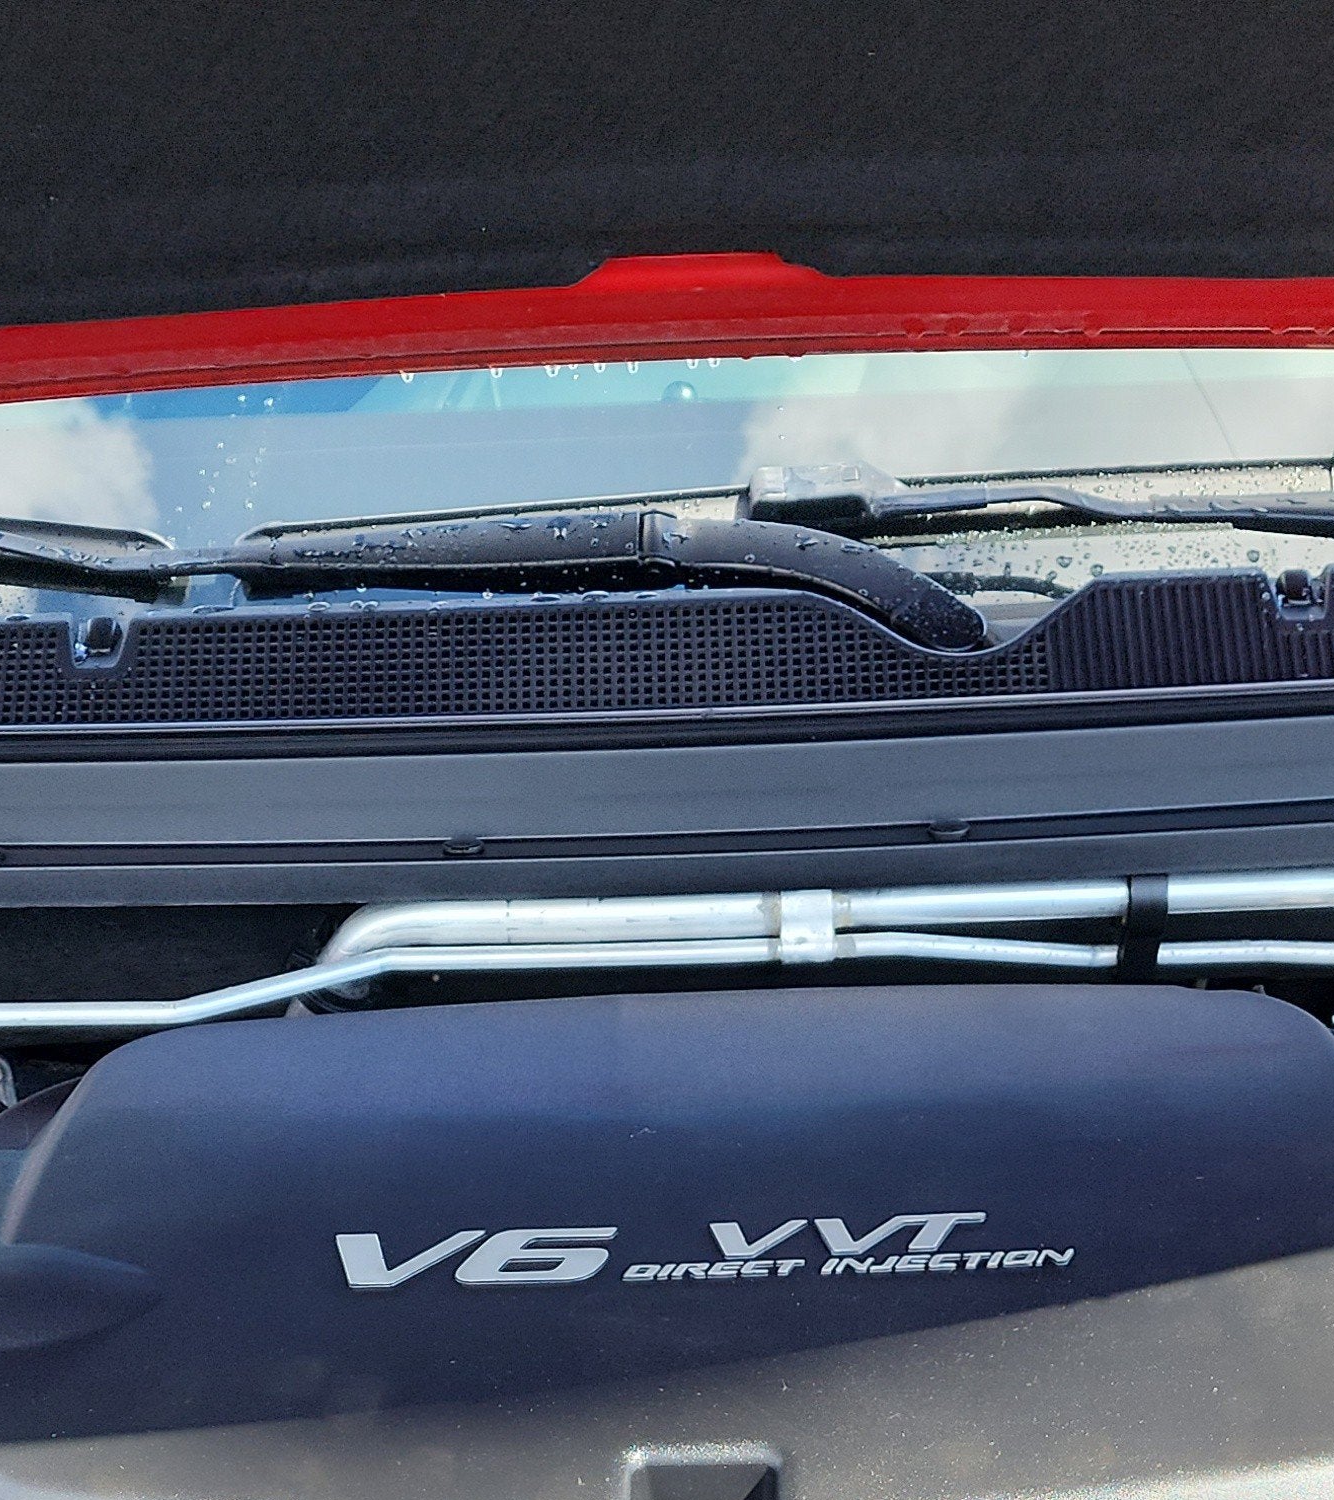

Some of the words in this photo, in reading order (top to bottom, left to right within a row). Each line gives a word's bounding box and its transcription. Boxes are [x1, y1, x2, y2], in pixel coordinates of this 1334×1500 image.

[335, 1226, 618, 1288] V6
[708, 1211, 987, 1260] VVT
[621, 1258, 806, 1282] DIRECT
[820, 1247, 1076, 1276] INJECTION
